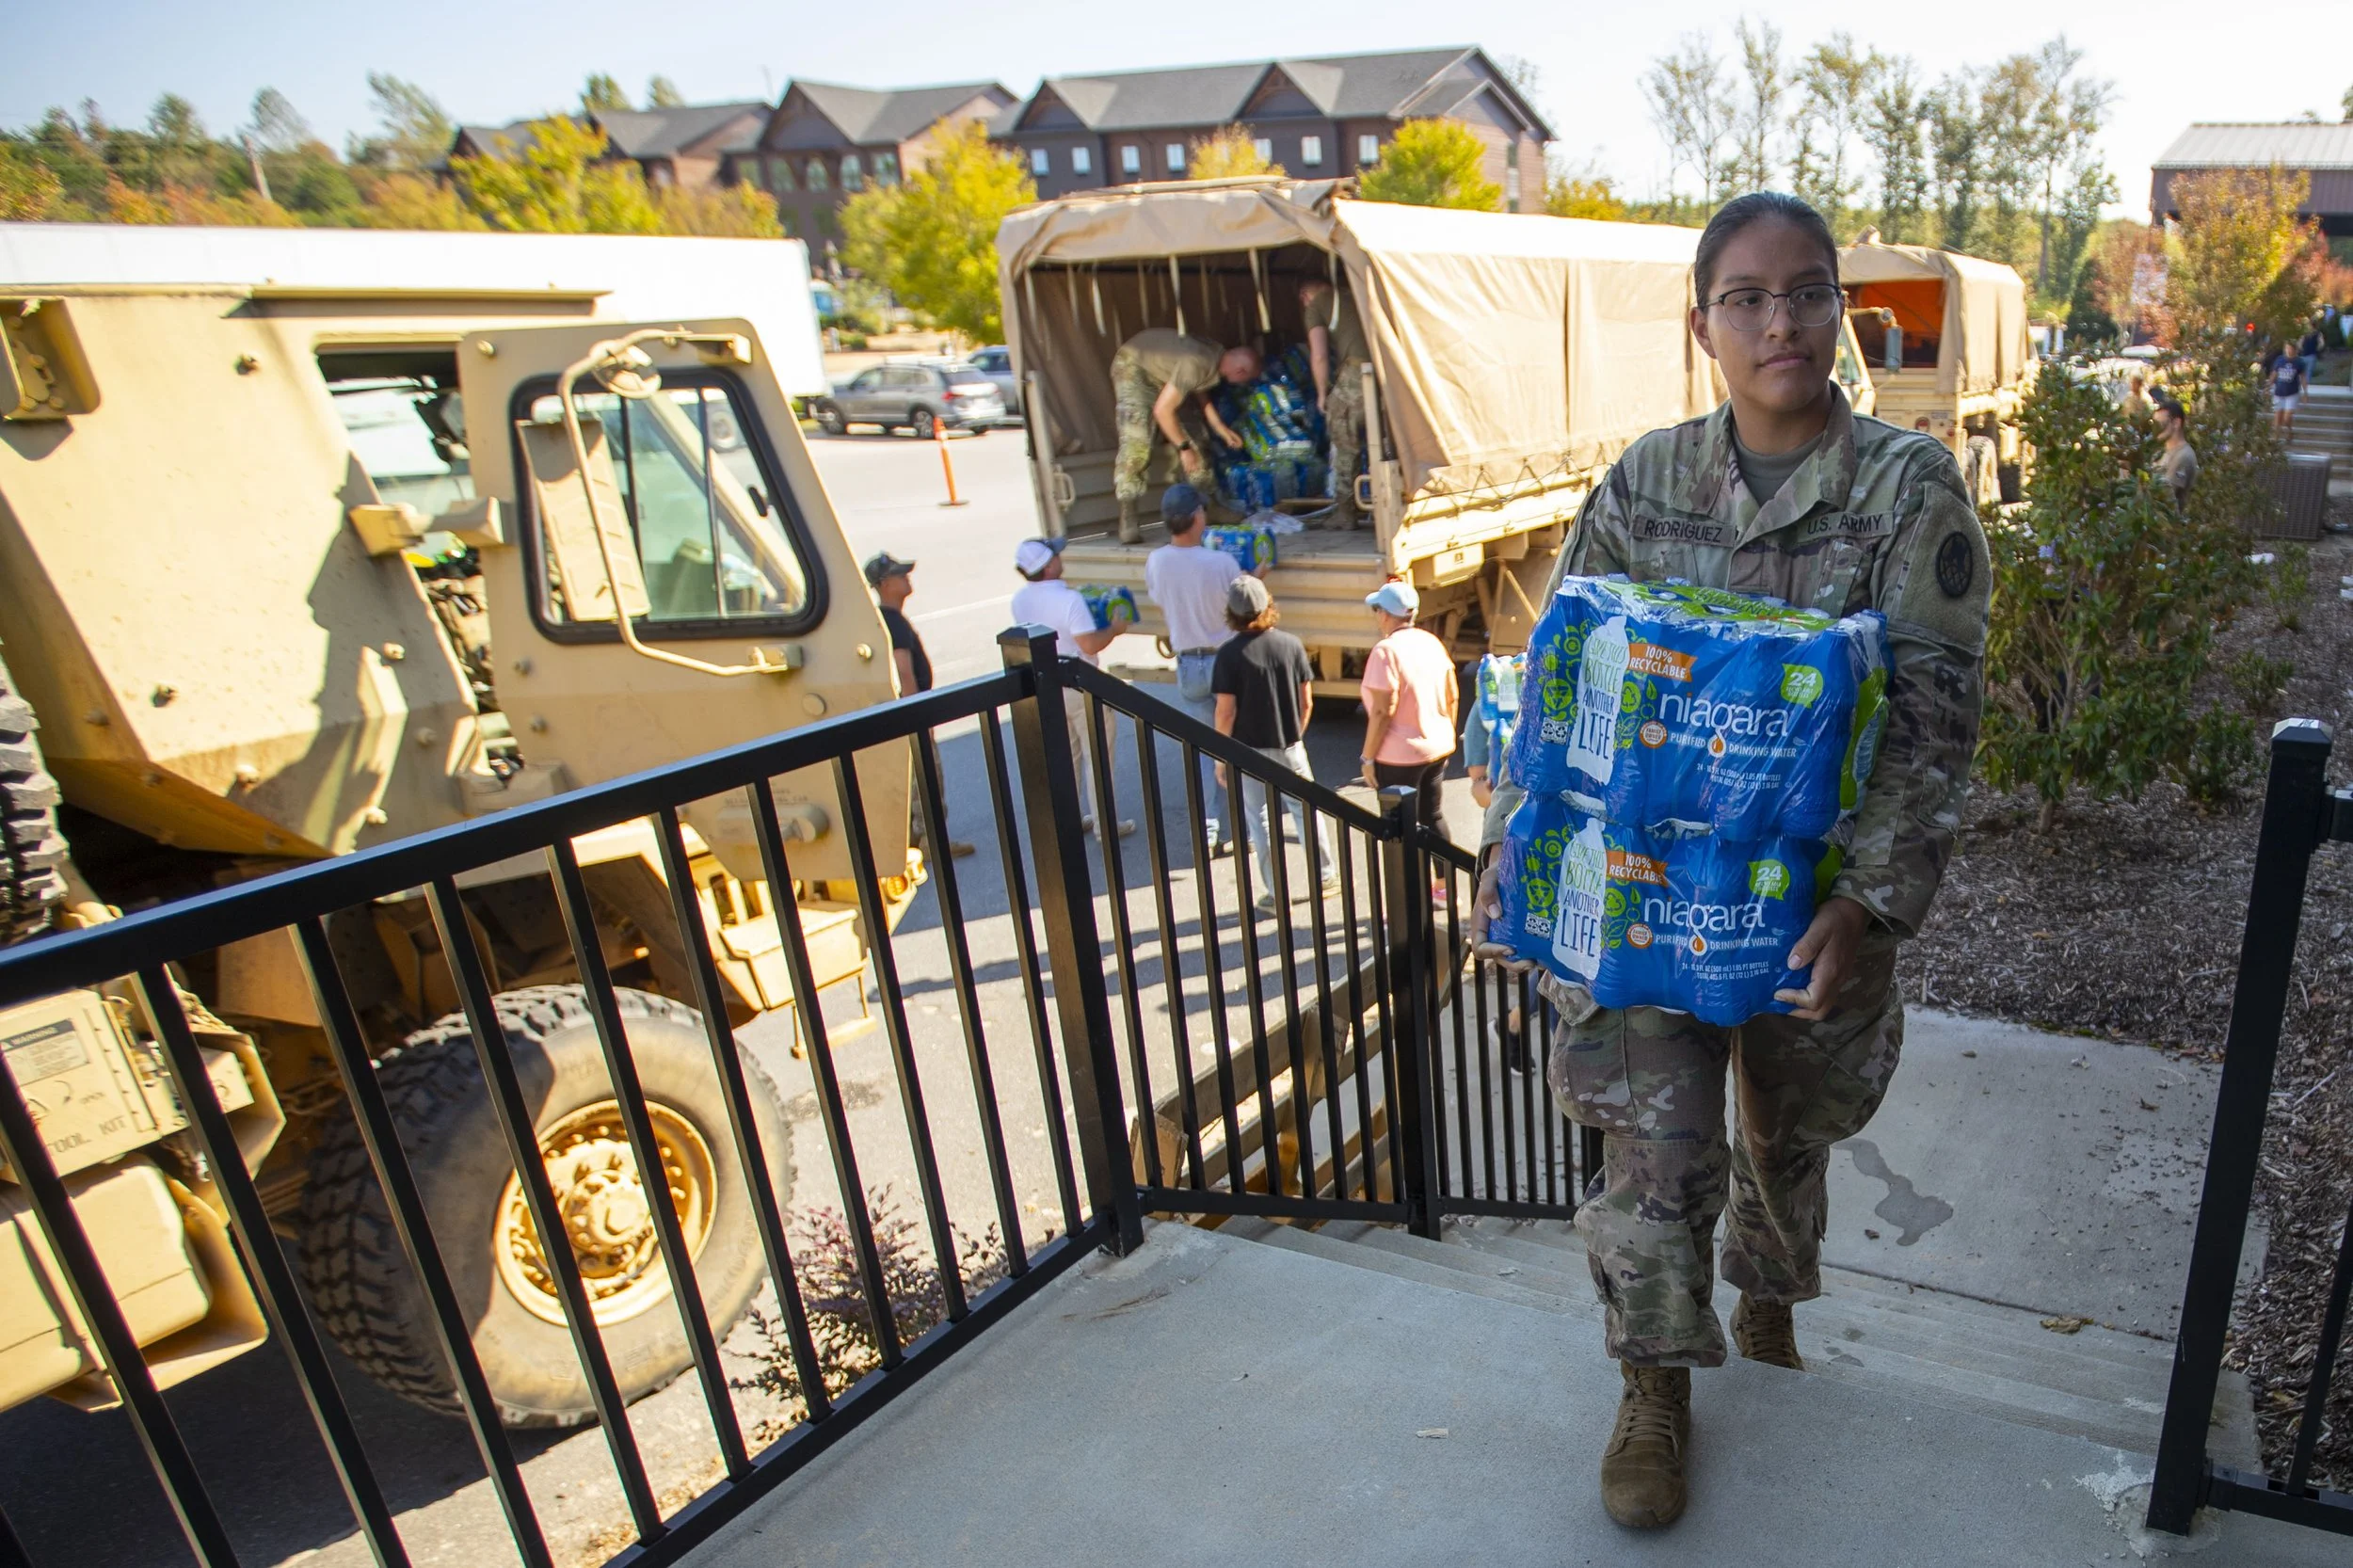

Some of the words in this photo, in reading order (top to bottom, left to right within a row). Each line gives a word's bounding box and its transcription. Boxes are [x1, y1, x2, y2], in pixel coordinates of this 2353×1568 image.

[1644, 519, 1723, 543] RODRIGUEZ
[1808, 517, 1831, 535] U.S.
[1838, 514, 1883, 533] ARMY
[1645, 646, 1673, 664] 100%
[1585, 658, 1622, 695] BOTTLE
[1629, 657, 1687, 679] RECYCLABLE
[1788, 672, 1817, 687] 24
[1582, 687, 1615, 716] ANOTHER
[1578, 708, 1612, 760] LIFE
[1659, 692, 1789, 757] niagara
[1729, 744, 1769, 757] DRINKING
[1770, 747, 1797, 758] WATER
[1625, 854, 1653, 869] 100%
[1565, 860, 1604, 896] BOTTLE
[1609, 864, 1663, 884] RECYCLABLE
[1756, 865, 1783, 882] 24
[1563, 888, 1600, 918] ANOTHER
[1560, 908, 1598, 958] LIFE
[1643, 896, 1767, 956] niagara
[1655, 934, 1689, 947] PURIFIED
[1710, 938, 1750, 951] DRINKING
[1751, 936, 1779, 948] WATER
[98, 1114, 127, 1136] KIT
